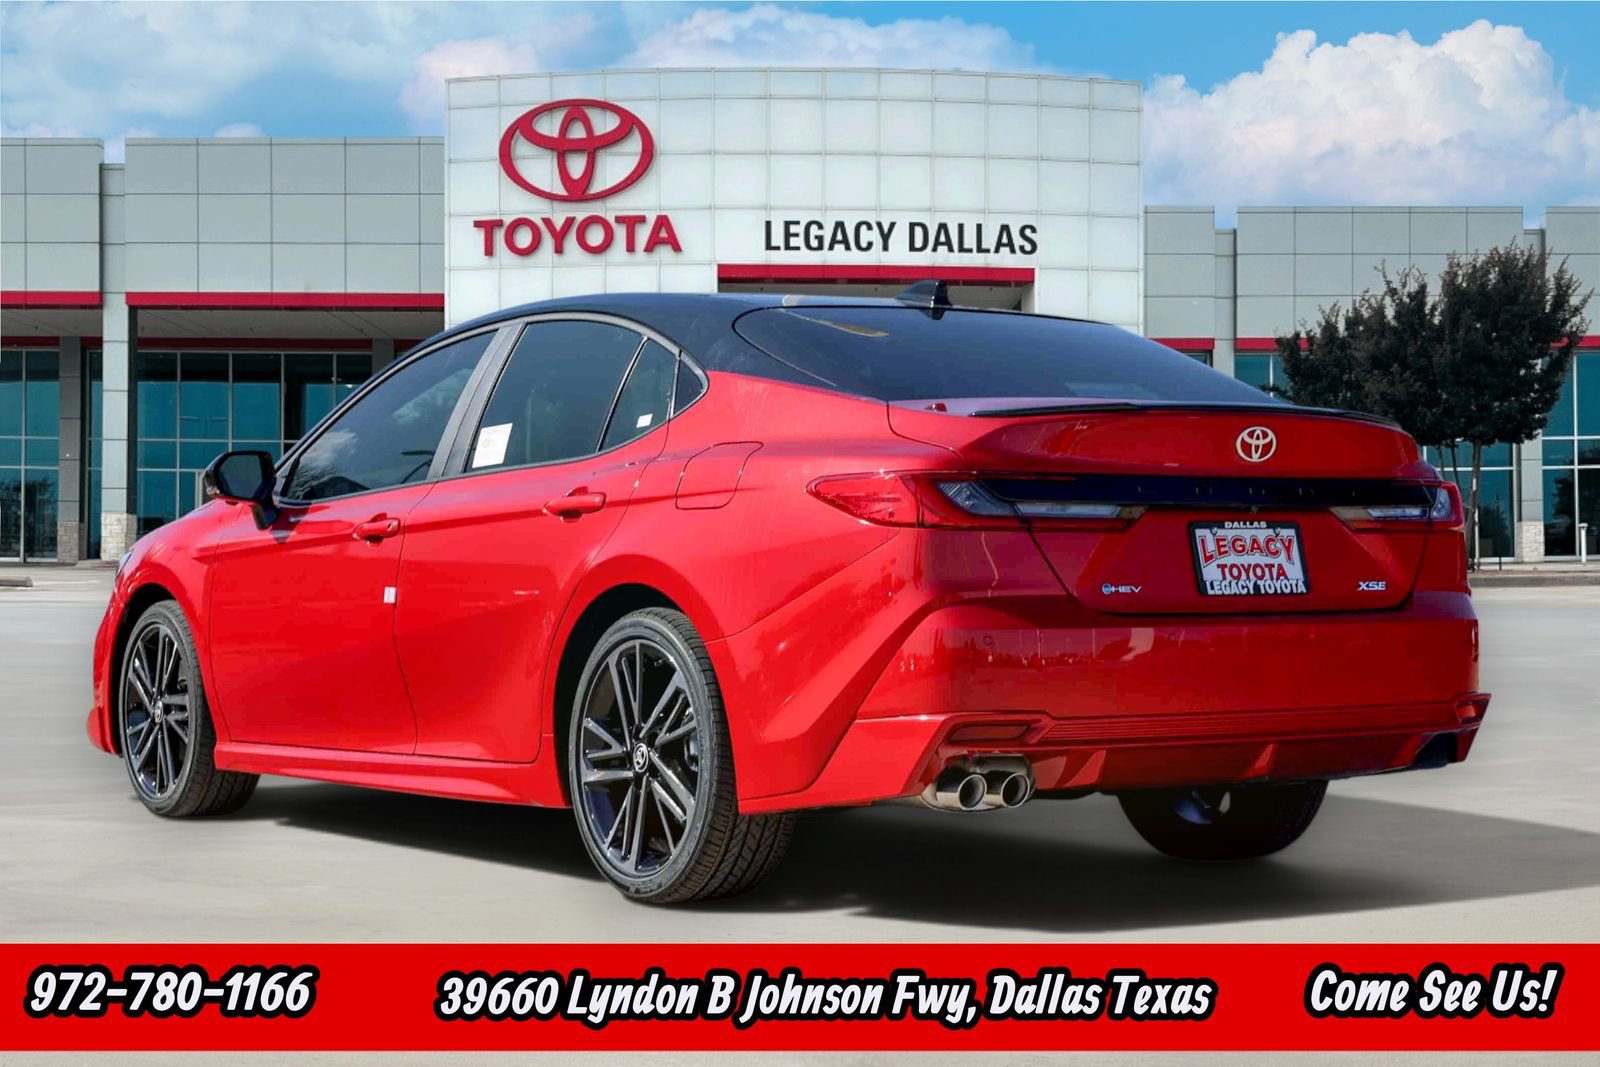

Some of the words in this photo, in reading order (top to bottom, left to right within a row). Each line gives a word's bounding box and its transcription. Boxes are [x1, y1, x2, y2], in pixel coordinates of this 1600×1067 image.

[473, 214, 682, 257] TOYOTA
[764, 219, 896, 252] LEGACY
[908, 220, 1038, 256] DALLAS
[1224, 521, 1268, 530] DALLAS
[1198, 535, 1295, 568] LEGACY
[1216, 563, 1289, 581] TOYOTA
[1206, 579, 1256, 596] LEGACY
[1257, 577, 1307, 595] TOYOTA
[1357, 581, 1387, 591] XSE
